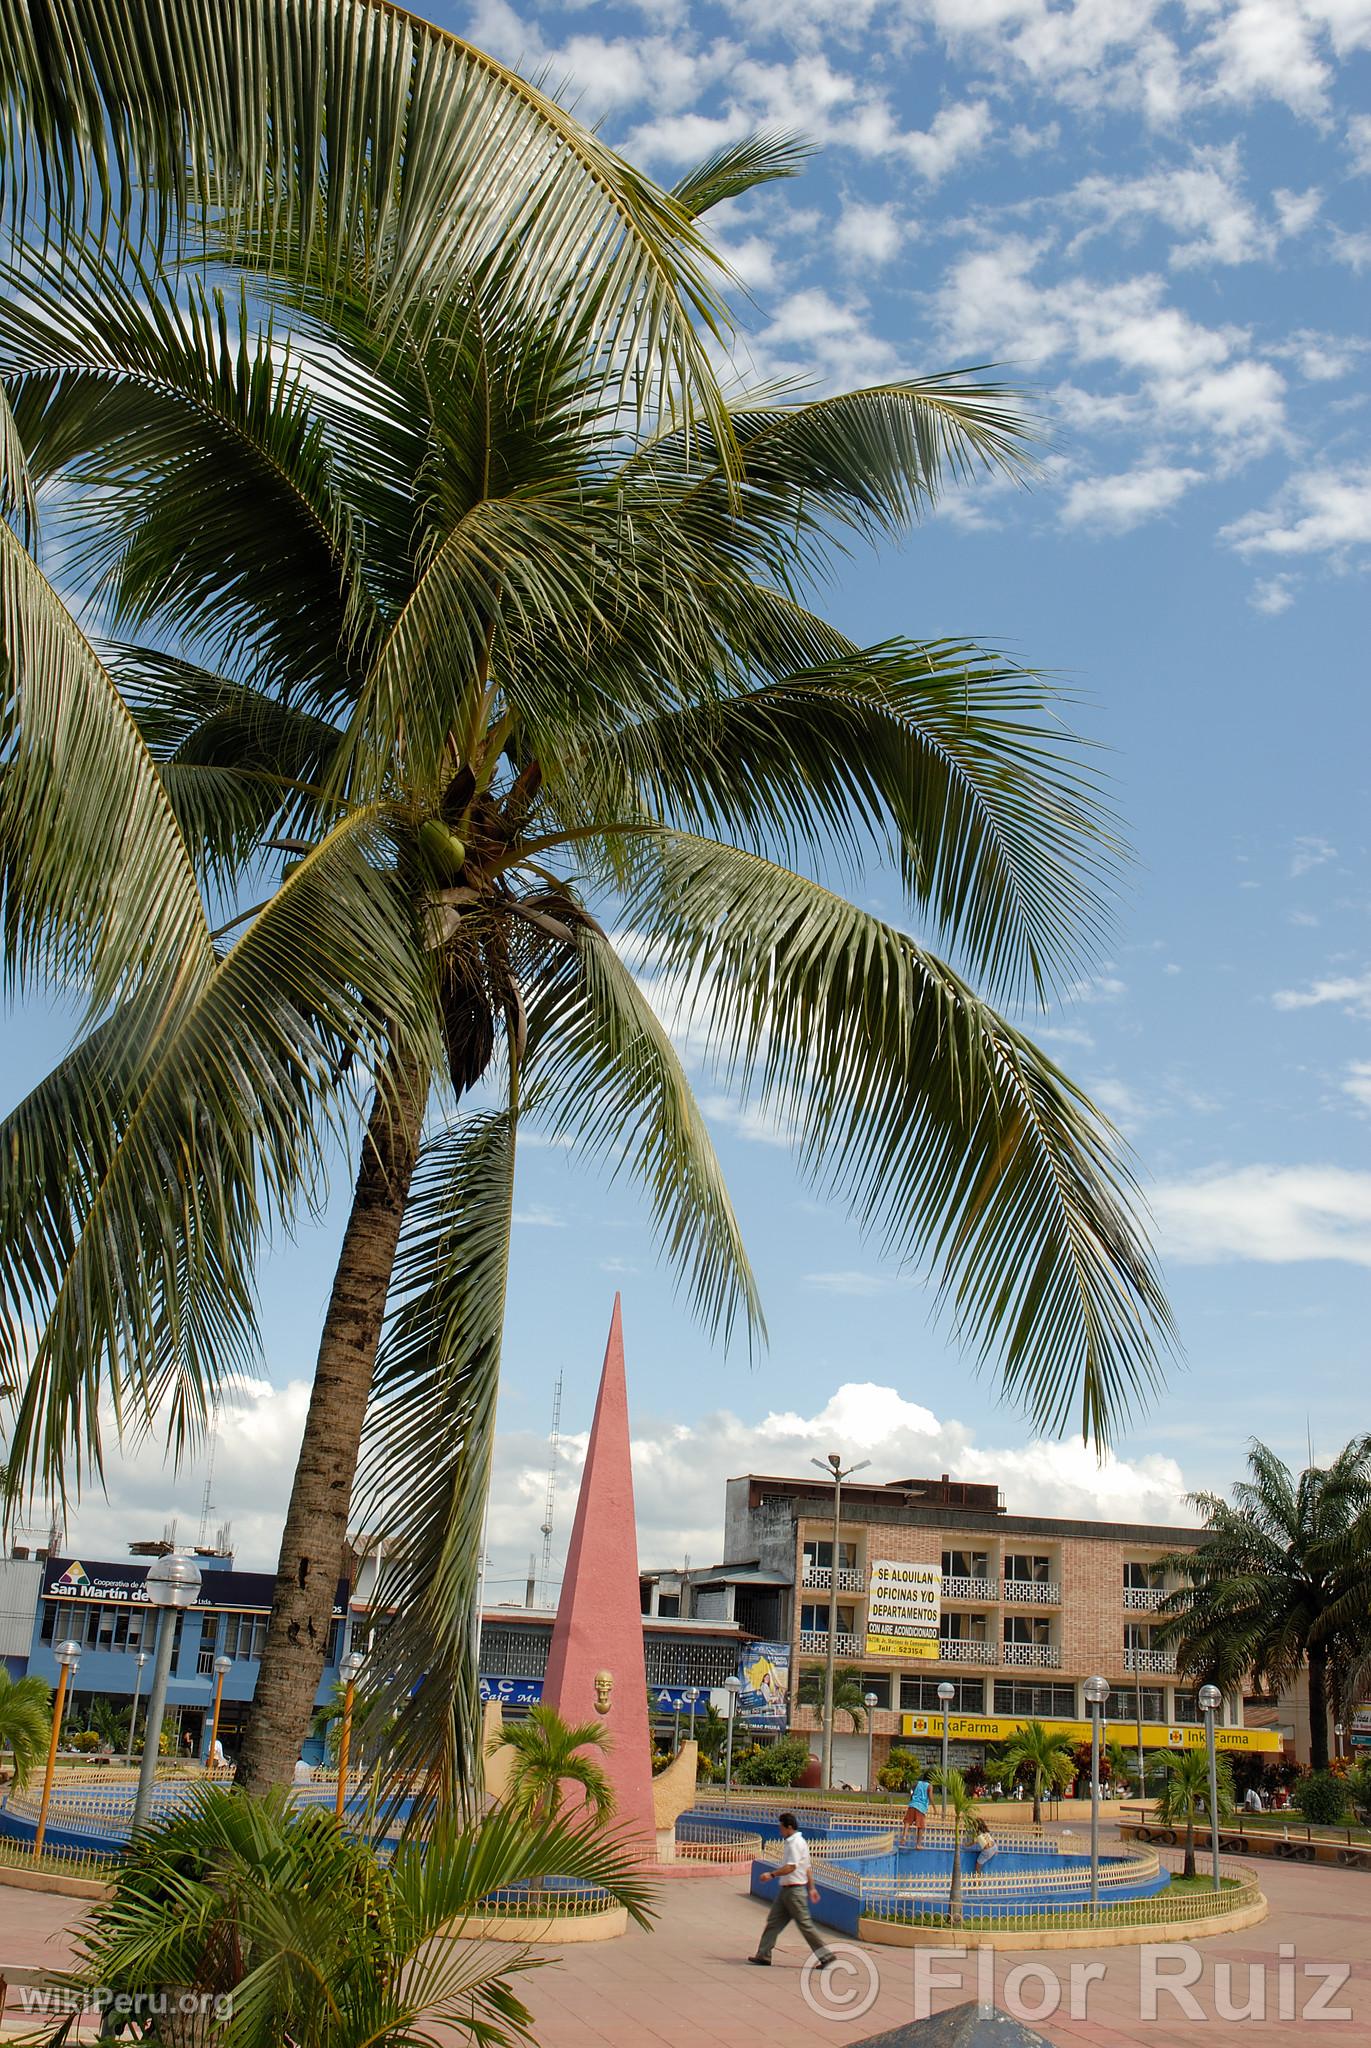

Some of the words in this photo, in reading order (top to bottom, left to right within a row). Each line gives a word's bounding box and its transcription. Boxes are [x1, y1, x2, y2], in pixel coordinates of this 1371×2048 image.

[93, 1578, 130, 1588] Cooperativa
[878, 1568, 889, 1580] SE
[891, 1570, 934, 1585] ALQUILAN
[50, 1583, 77, 1596] San
[80, 1586, 128, 1600] Martín
[131, 1589, 149, 1602] de
[877, 1586, 918, 1602] OFICINAS
[920, 1591, 935, 1603] Y/O
[873, 1604, 938, 1621] DEPARTAMENTOS
[868, 1623, 881, 1634] CON
[880, 1624, 893, 1635] AIRE
[894, 1625, 937, 1639] ACONDICIONADO
[898, 1646, 923, 1655] 523154
[480, 1691, 510, 1702] Caja
[1188, 1731, 1249, 1744] InkFarma
